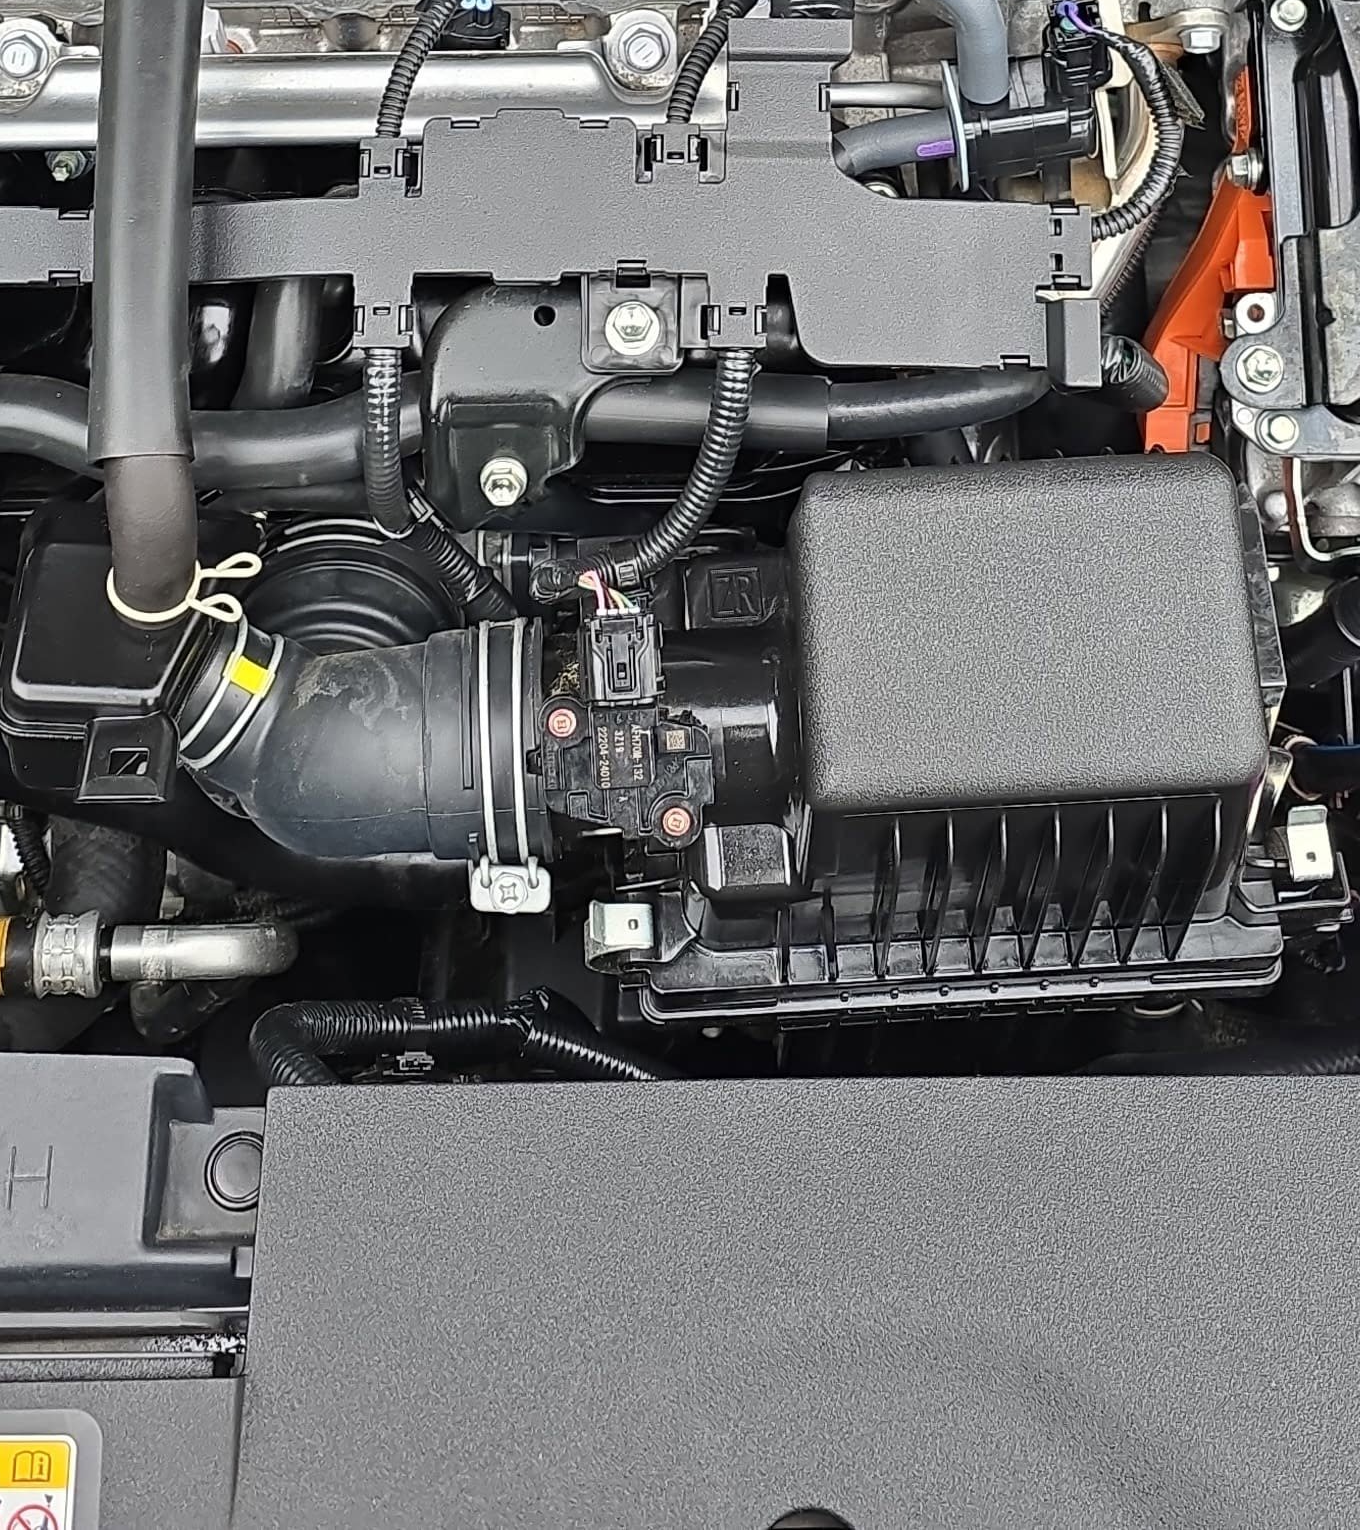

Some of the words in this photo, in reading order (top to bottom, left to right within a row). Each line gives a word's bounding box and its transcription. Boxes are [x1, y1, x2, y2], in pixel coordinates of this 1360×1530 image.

[716, 575, 756, 615] ZR
[597, 726, 611, 789] 22204-24010
[6, 1146, 54, 1209] H
